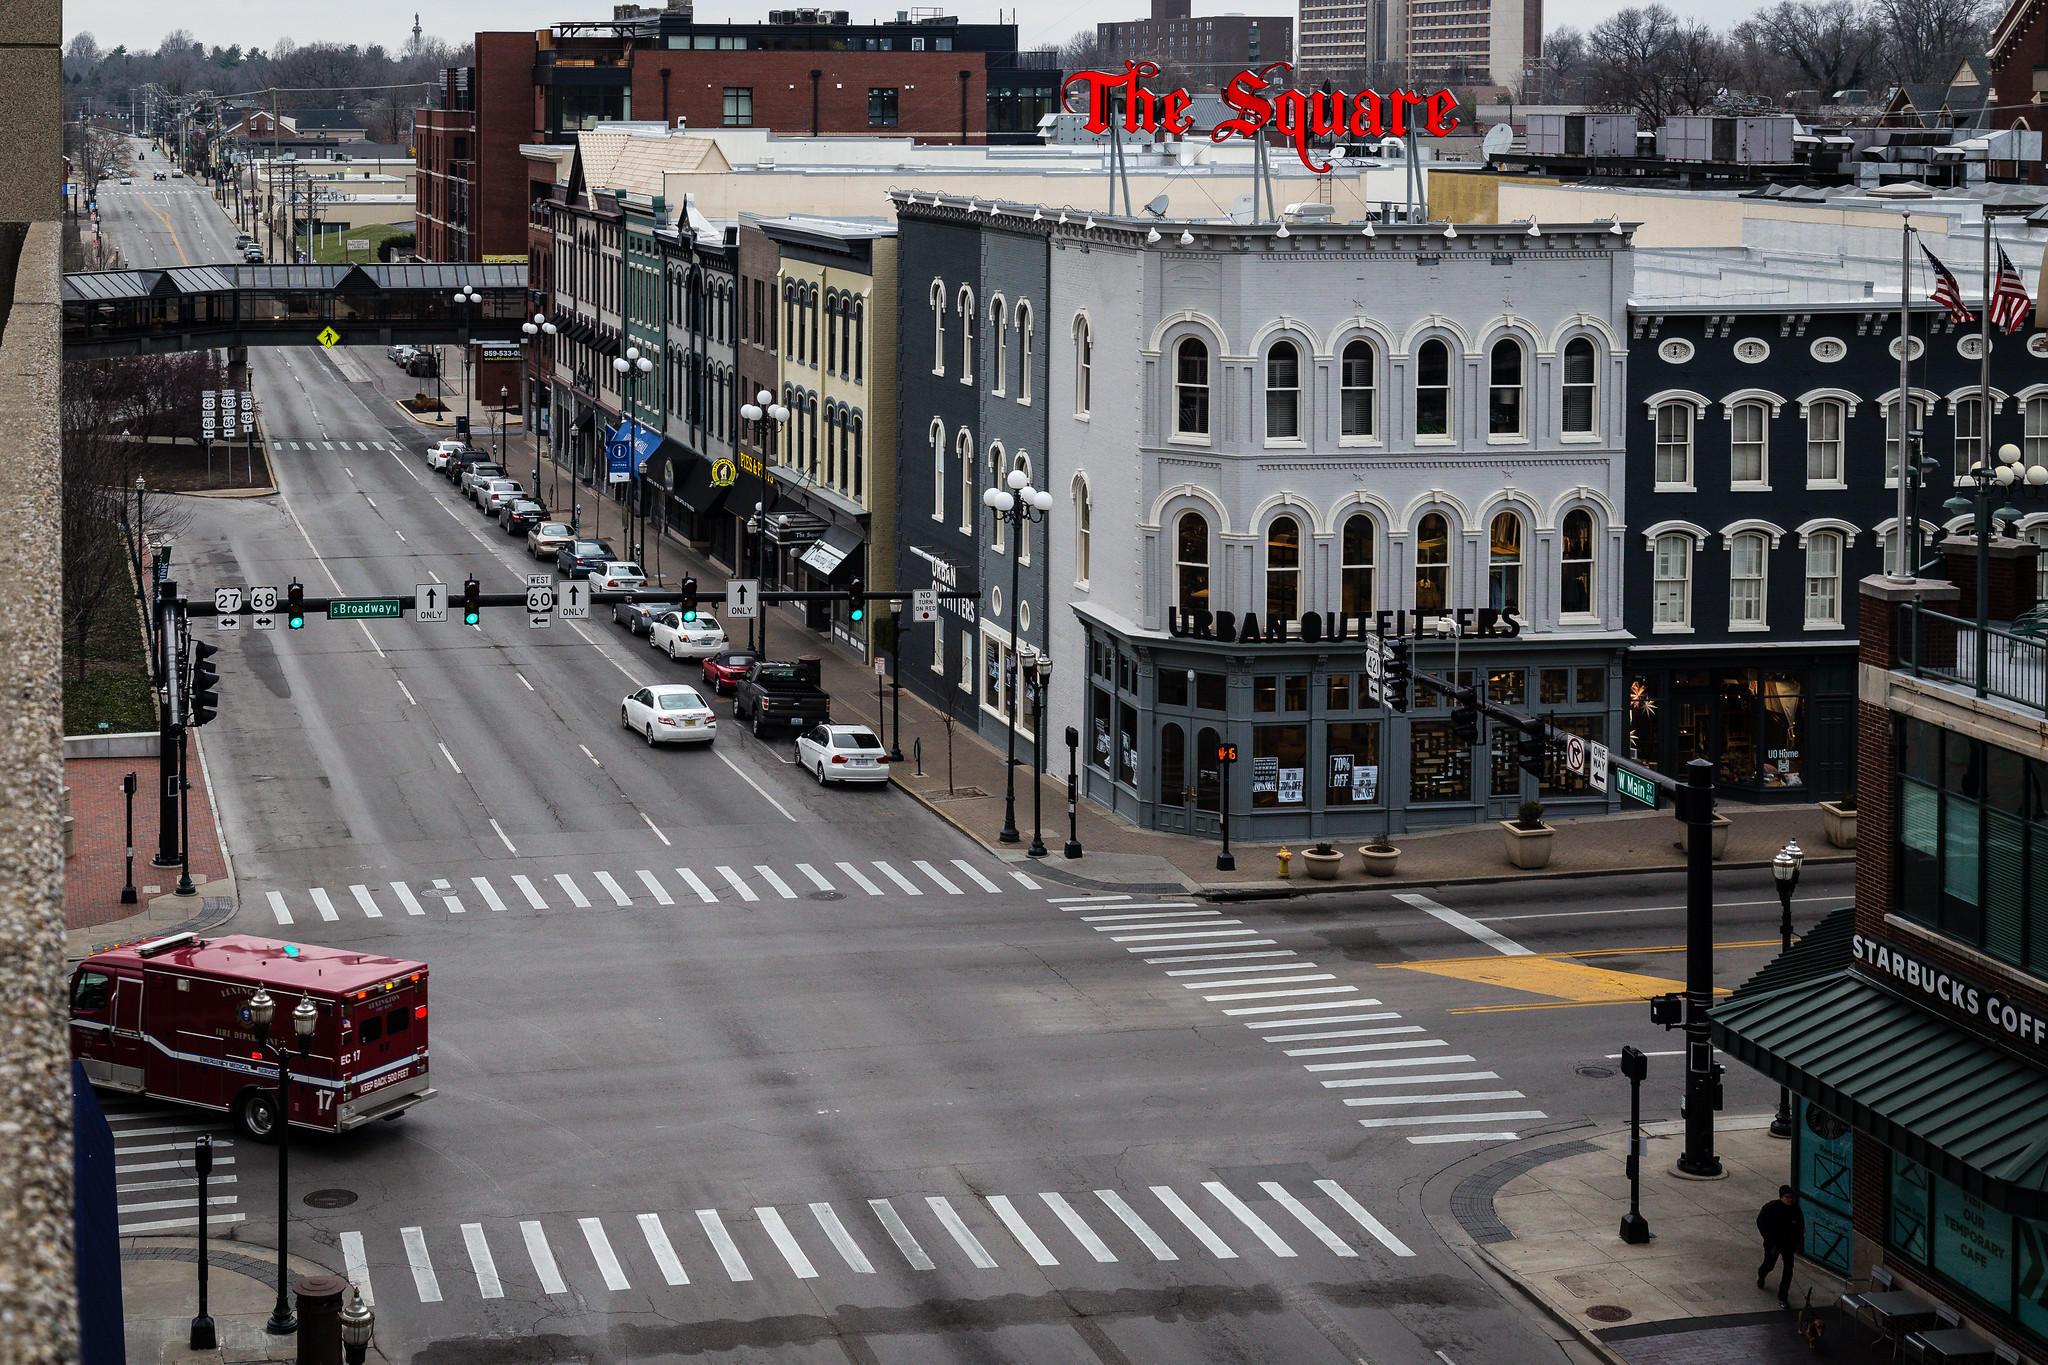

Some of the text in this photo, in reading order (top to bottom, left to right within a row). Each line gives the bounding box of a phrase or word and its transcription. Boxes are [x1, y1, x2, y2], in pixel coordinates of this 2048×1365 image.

[1061, 60, 1459, 172] The Square
[204, 400, 214, 408] 25
[242, 400, 251, 408] 25
[224, 418, 234, 426] 60
[740, 452, 753, 472] PIES
[753, 459, 757, 475] &
[931, 555, 956, 588] URBAN
[217, 594, 240, 608] 27
[253, 593, 275, 607] 68
[529, 593, 550, 607] 60
[339, 603, 392, 615] Broadway
[420, 611, 443, 619] ONLY
[562, 608, 585, 616] ONLY
[731, 606, 753, 615] ONLY
[1168, 606, 1521, 643] URBAN OUTFITTERS
[1367, 655, 1379, 676] 421
[1228, 747, 1236, 760] 6
[1593, 746, 1606, 760] ONE
[1767, 749, 1799, 759] UO Home
[1334, 757, 1350, 772] 70%
[1593, 758, 1606, 771] WAY
[1265, 781, 1276, 790] OFF
[1292, 780, 1302, 790] OFF
[1334, 773, 1349, 787] OFF
[1618, 771, 1626, 790] W
[1627, 776, 1645, 798] Main
[1365, 788, 1375, 797] OFF
[1852, 934, 2046, 1045] STARBUCKS COFF
[215, 1028, 231, 1037] FIRE
[340, 1050, 360, 1065] EC 17
[360, 1067, 409, 1093] KEEP BACK 500 FEET
[315, 1088, 335, 1110] 17
[1963, 1208, 1985, 1230] OUR
[1943, 1214, 2005, 1259] TEMPORARY
[1960, 1243, 1988, 1269] CAFE
